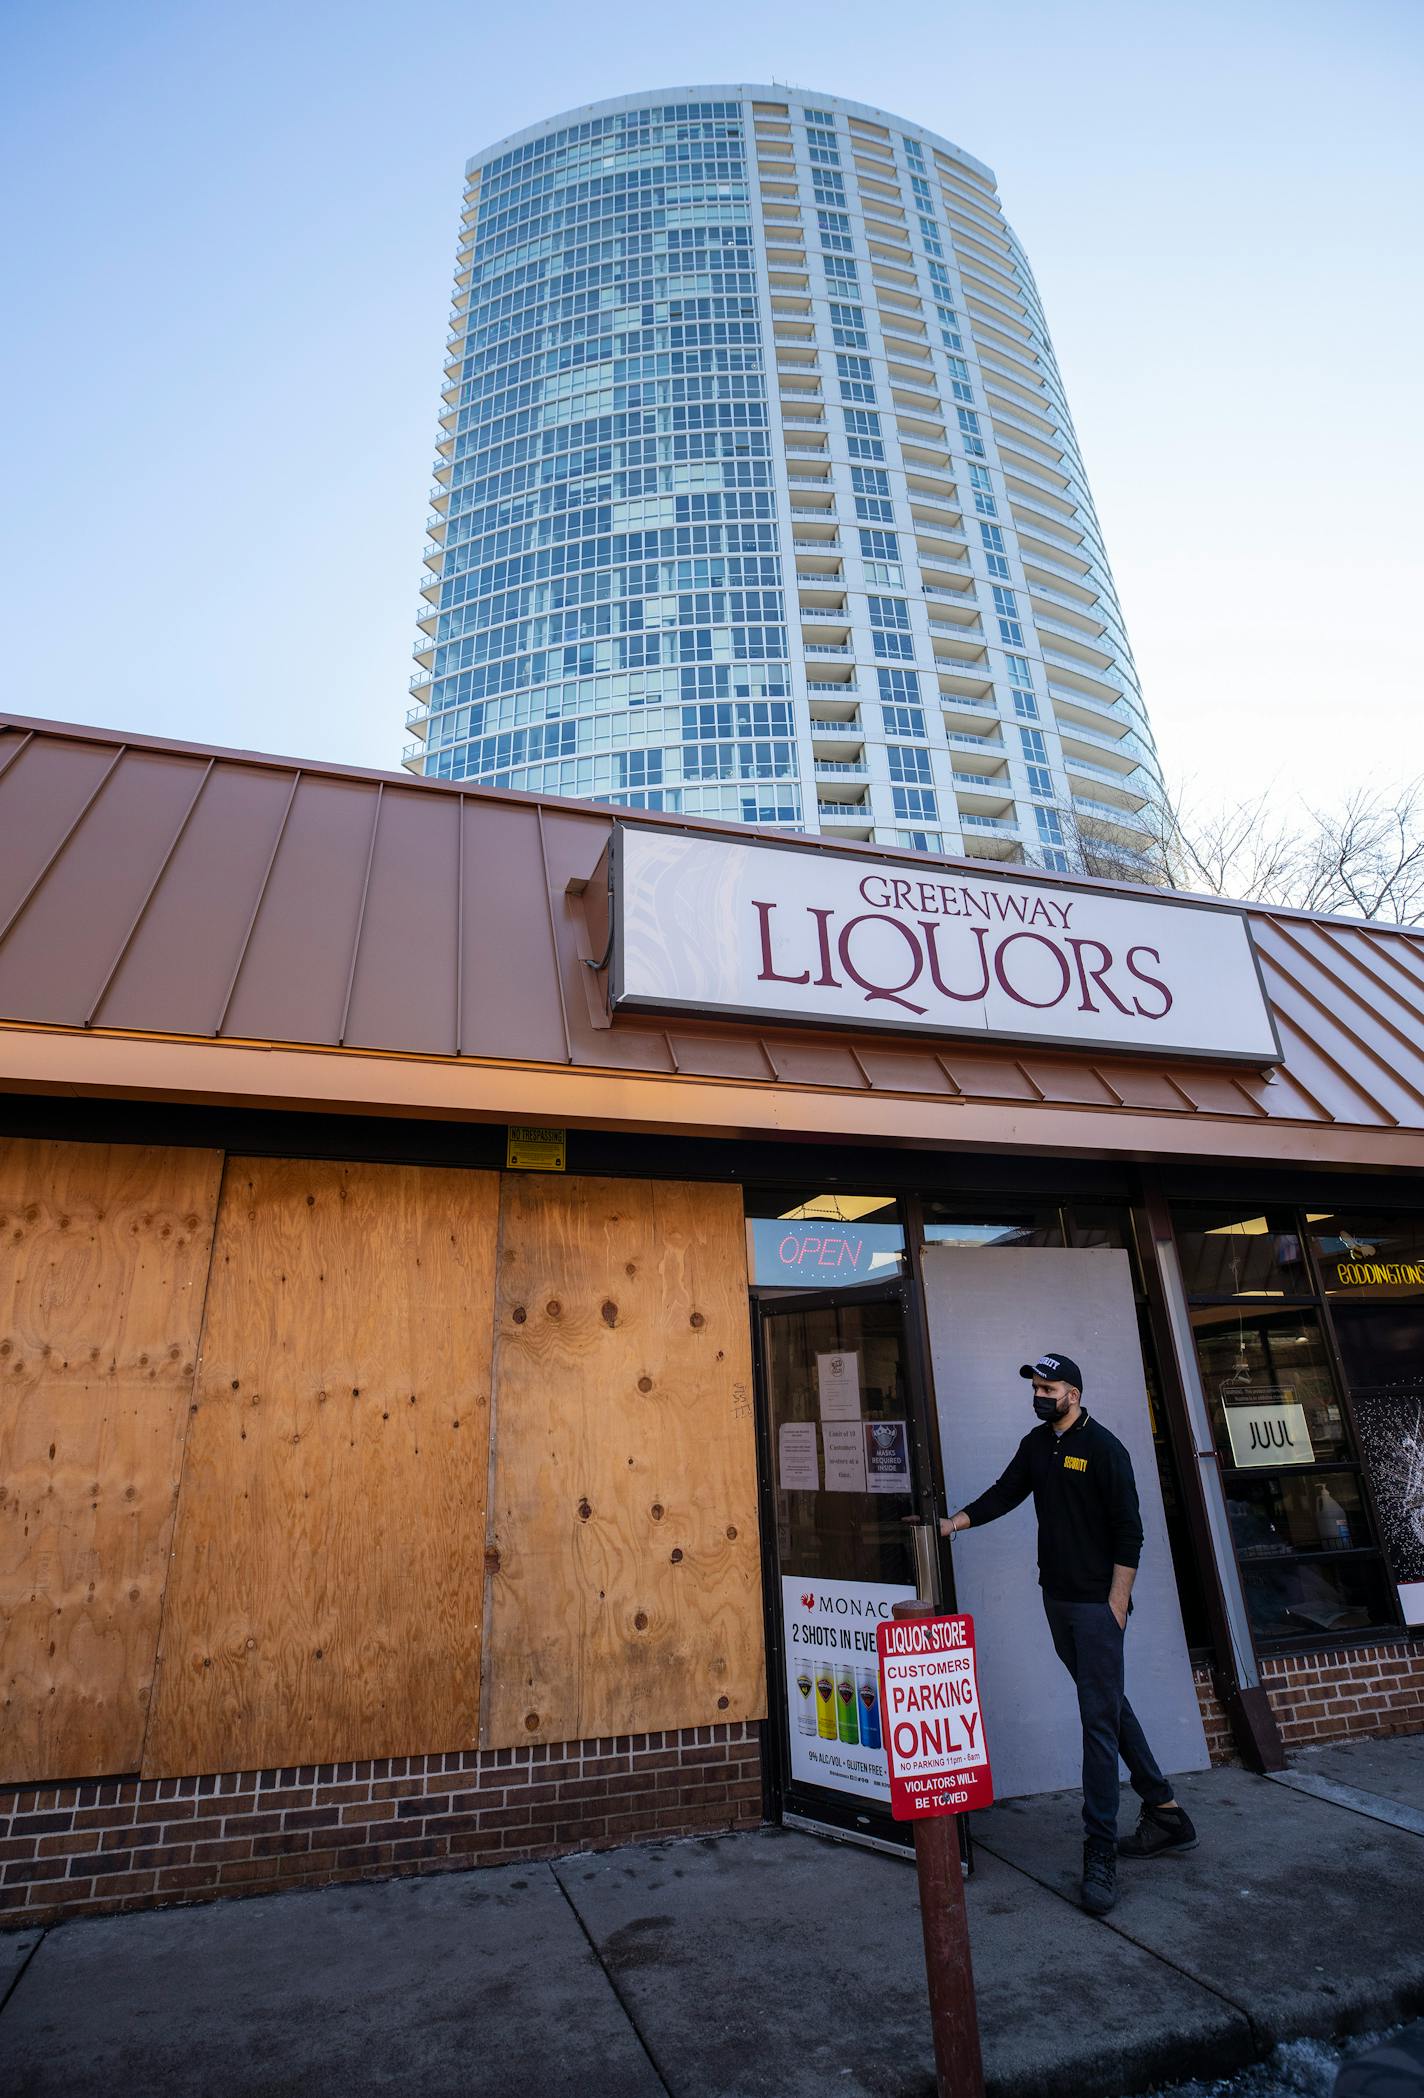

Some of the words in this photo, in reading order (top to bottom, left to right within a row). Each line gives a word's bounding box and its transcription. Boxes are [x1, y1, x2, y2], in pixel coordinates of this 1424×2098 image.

[858, 875, 1074, 929] GREENWAY
[750, 900, 1174, 1021] LIQUORS
[511, 1127, 521, 1141] NO
[522, 1128, 563, 1143] TRESPASSING
[779, 1236, 863, 1266] OPEN
[1249, 1420, 1294, 1450] JUUL
[872, 1457, 902, 1465] REQUIRED
[876, 1449, 896, 1457] MASKS
[819, 1596, 895, 1619] MONAC
[792, 1623, 800, 1643] 2
[802, 1624, 837, 1648] SHOTS
[840, 1629, 851, 1650] IN
[854, 1631, 877, 1653] EVE
[885, 1625, 931, 1654] LIQUOR
[931, 1620, 967, 1650] STORE
[887, 1658, 970, 1679] CUSTOMERS
[892, 1678, 973, 1714] PARKING
[893, 1711, 978, 1759] ONLY
[808, 1750, 818, 1762] 9%
[818, 1753, 843, 1768] ALC/VOL
[846, 1759, 868, 1774] GLUTEN
[868, 1764, 883, 1777] FREE
[900, 1763, 911, 1771] NO
[913, 1758, 945, 1770] PARKING
[946, 1756, 963, 1766] 11pm
[904, 1775, 956, 1793] VIOLATORS
[956, 1771, 978, 1786] WILL
[914, 1796, 931, 1809] BE
[931, 1791, 968, 1807] TOWED
